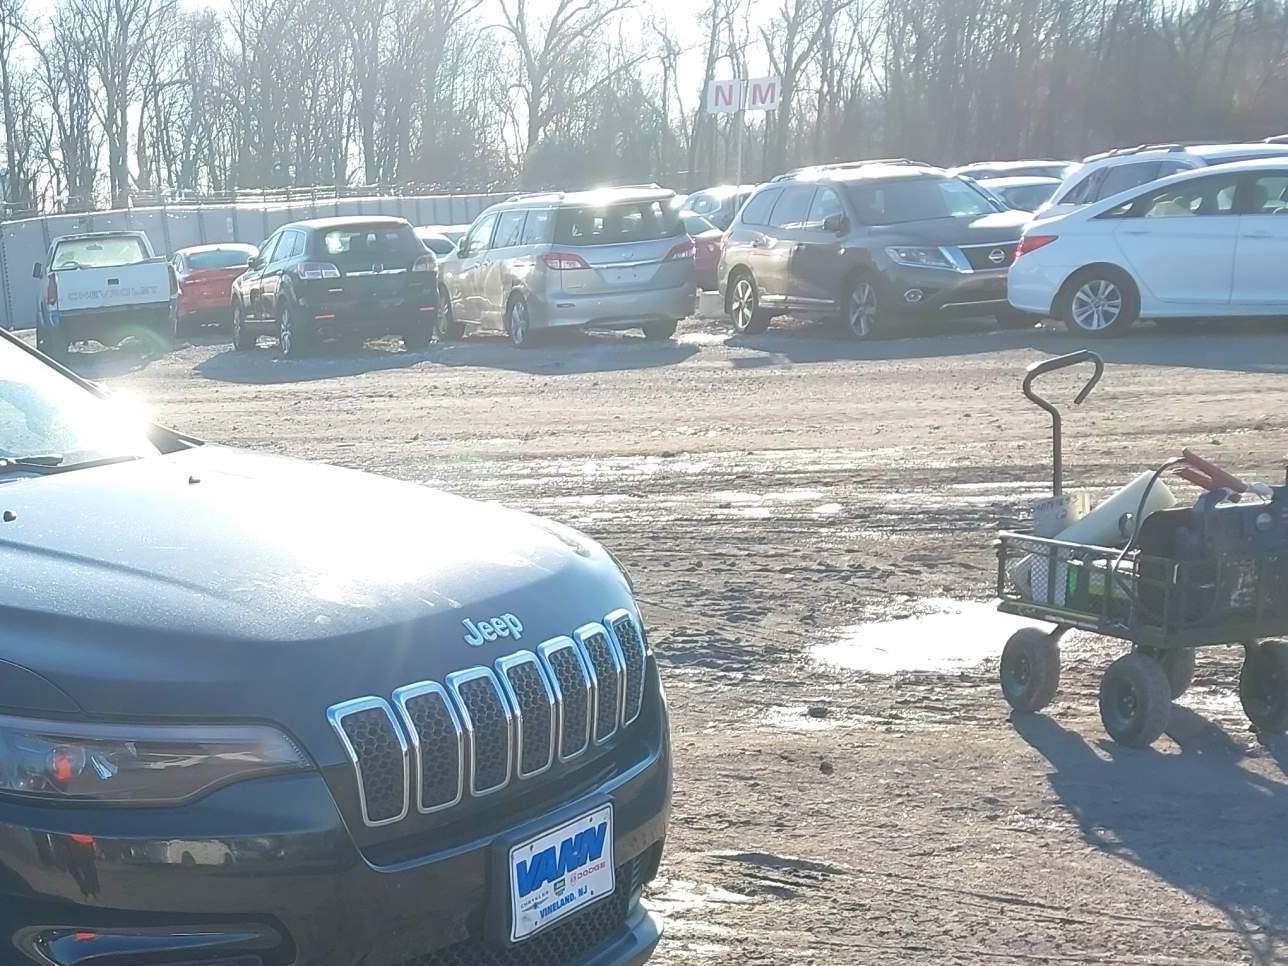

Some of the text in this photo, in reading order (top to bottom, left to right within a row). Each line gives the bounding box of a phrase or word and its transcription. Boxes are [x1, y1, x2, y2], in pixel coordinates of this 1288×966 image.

[715, 84, 733, 107] N
[752, 82, 776, 105] M
[462, 613, 523, 646] Jeep
[577, 861, 606, 879] DODGE
[578, 885, 588, 897] NJ
